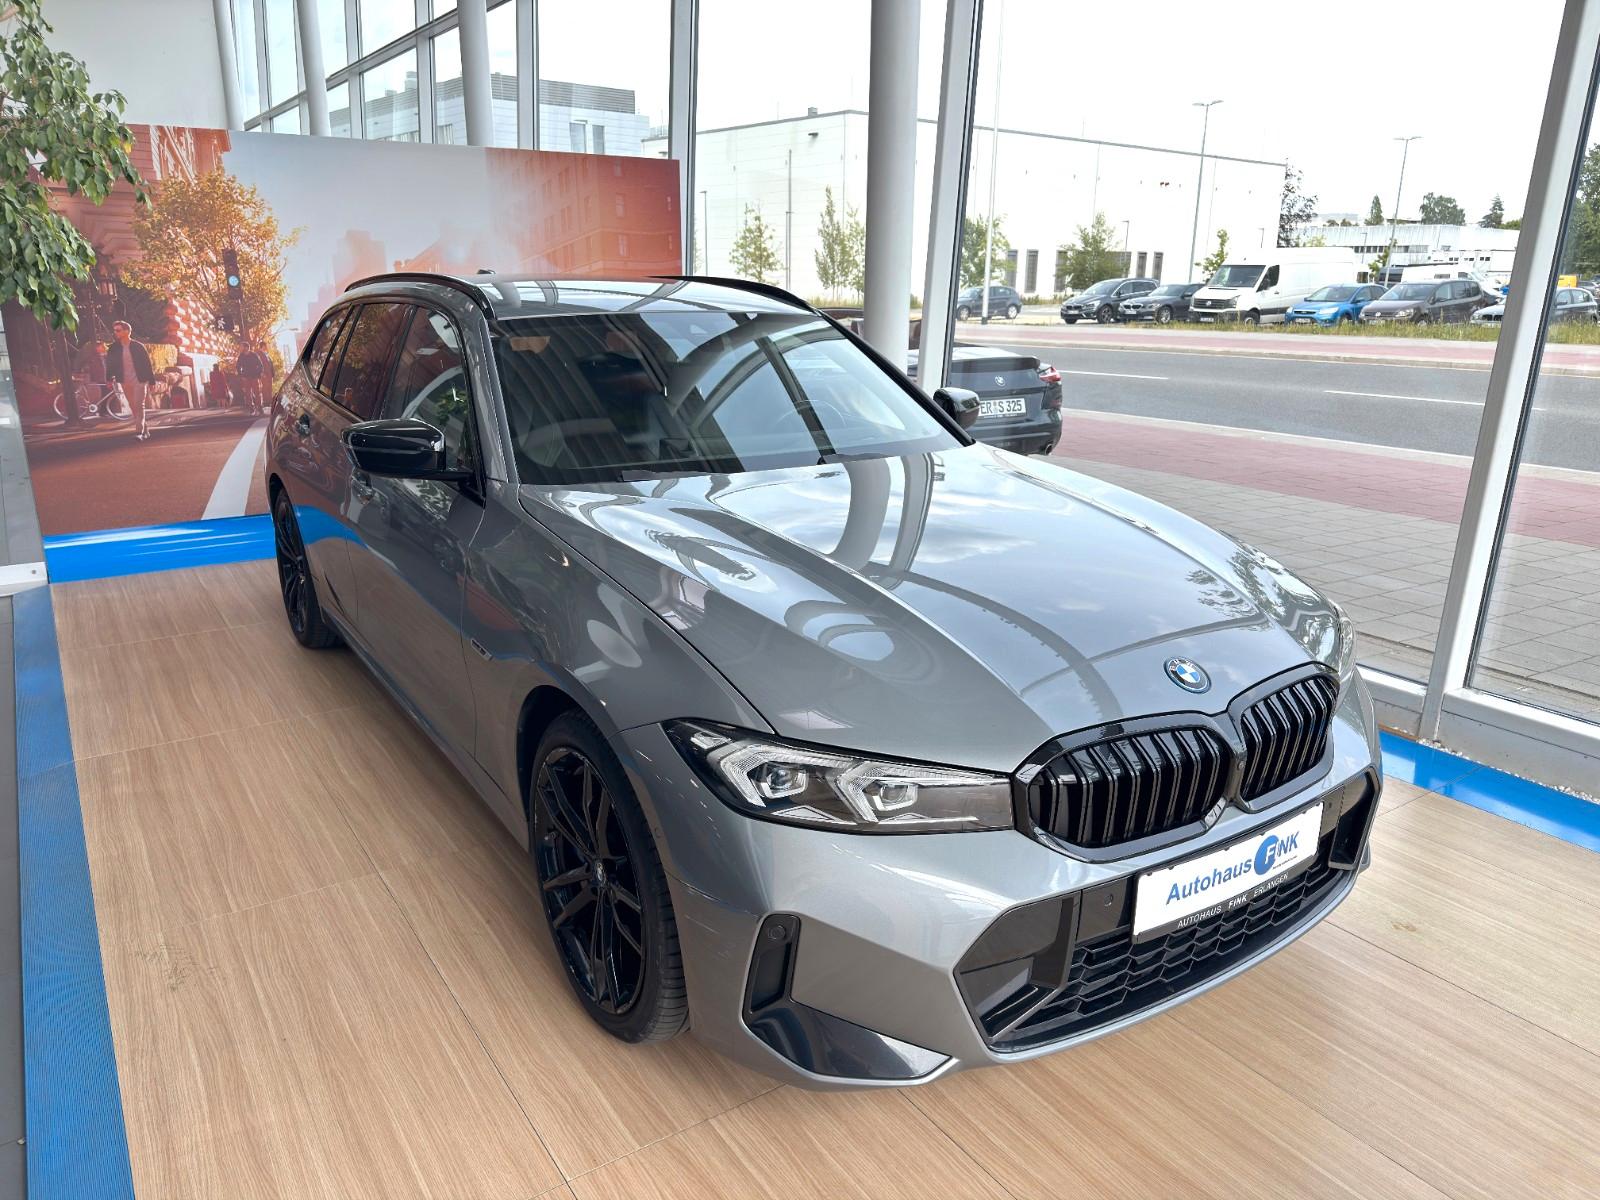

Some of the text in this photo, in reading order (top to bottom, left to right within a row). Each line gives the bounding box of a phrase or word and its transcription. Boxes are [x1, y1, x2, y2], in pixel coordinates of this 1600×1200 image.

[980, 400, 1022, 414] ER S 325
[1165, 831, 1300, 906] Autohaus FINK
[1177, 873, 1288, 929] AUTOHAUS FINK ERLANGEN
